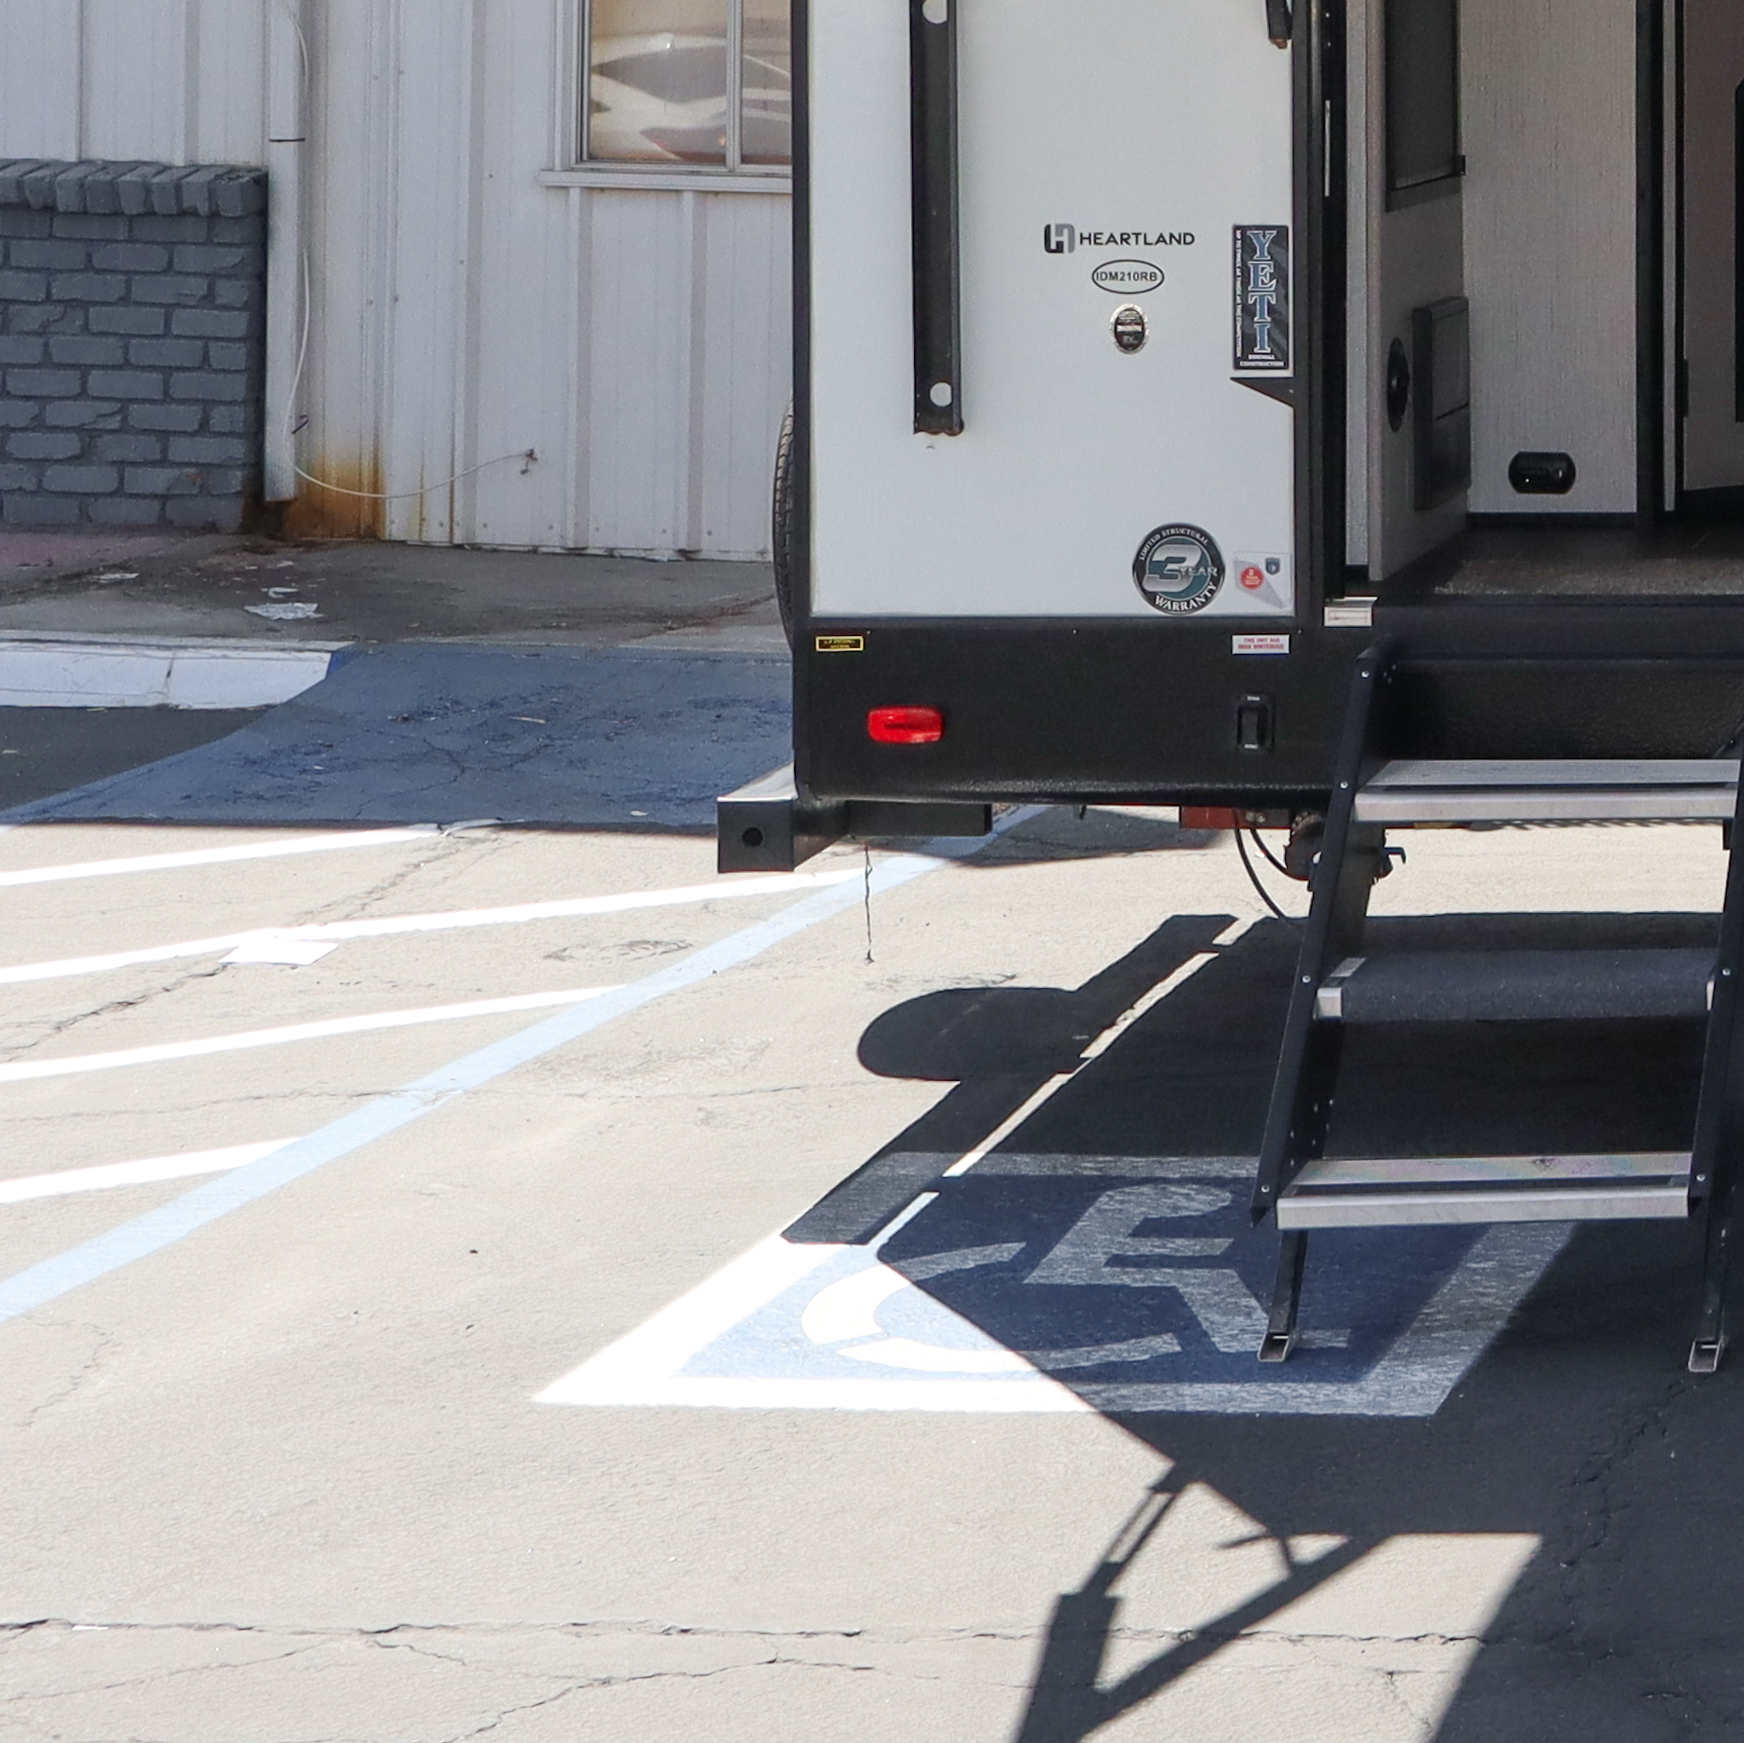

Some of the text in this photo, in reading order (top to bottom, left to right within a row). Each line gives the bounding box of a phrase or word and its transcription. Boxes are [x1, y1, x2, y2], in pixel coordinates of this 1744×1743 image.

[1079, 232, 1195, 246] HEARTLAND
[1096, 271, 1158, 282] IDM210RB
[1246, 230, 1278, 354] YETI
[1142, 544, 1202, 592] 3
[1178, 566, 1218, 577] YEAR
[1155, 582, 1217, 611] WARRANTY
